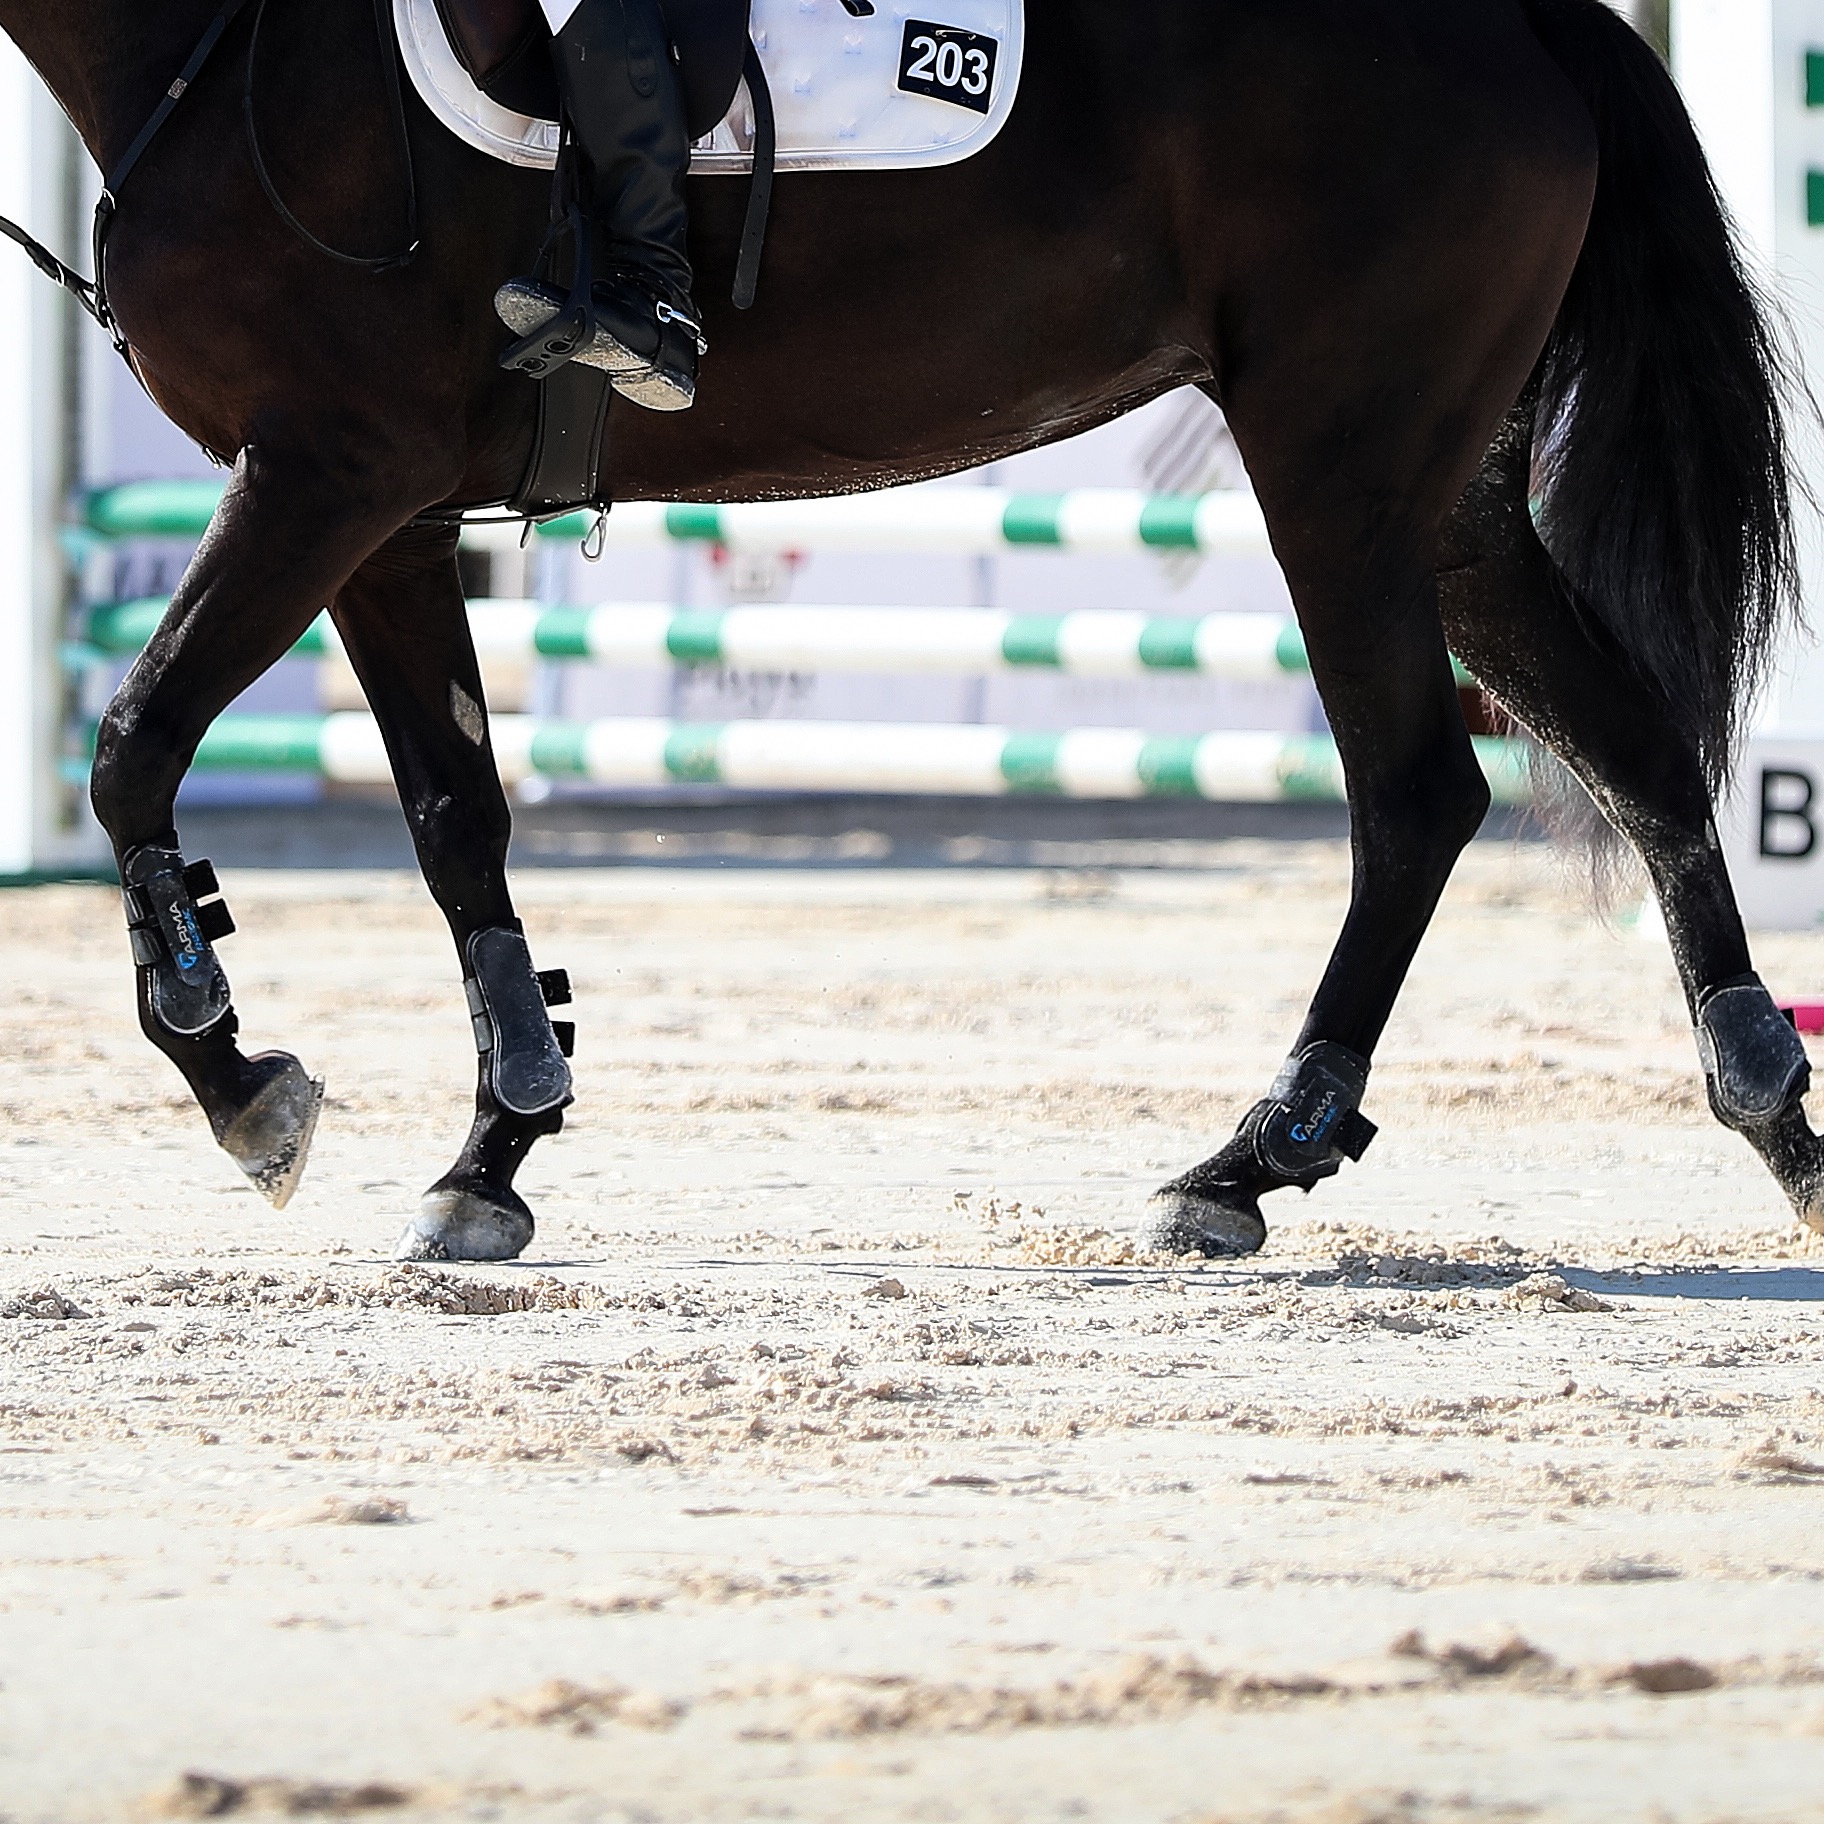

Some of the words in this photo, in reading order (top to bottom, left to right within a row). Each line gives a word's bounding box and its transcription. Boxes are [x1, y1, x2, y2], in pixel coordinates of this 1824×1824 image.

[906, 36, 989, 95] 203
[1759, 768, 1816, 859] B
[169, 900, 196, 954] ARMA
[1304, 1090, 1336, 1137] ARMA
